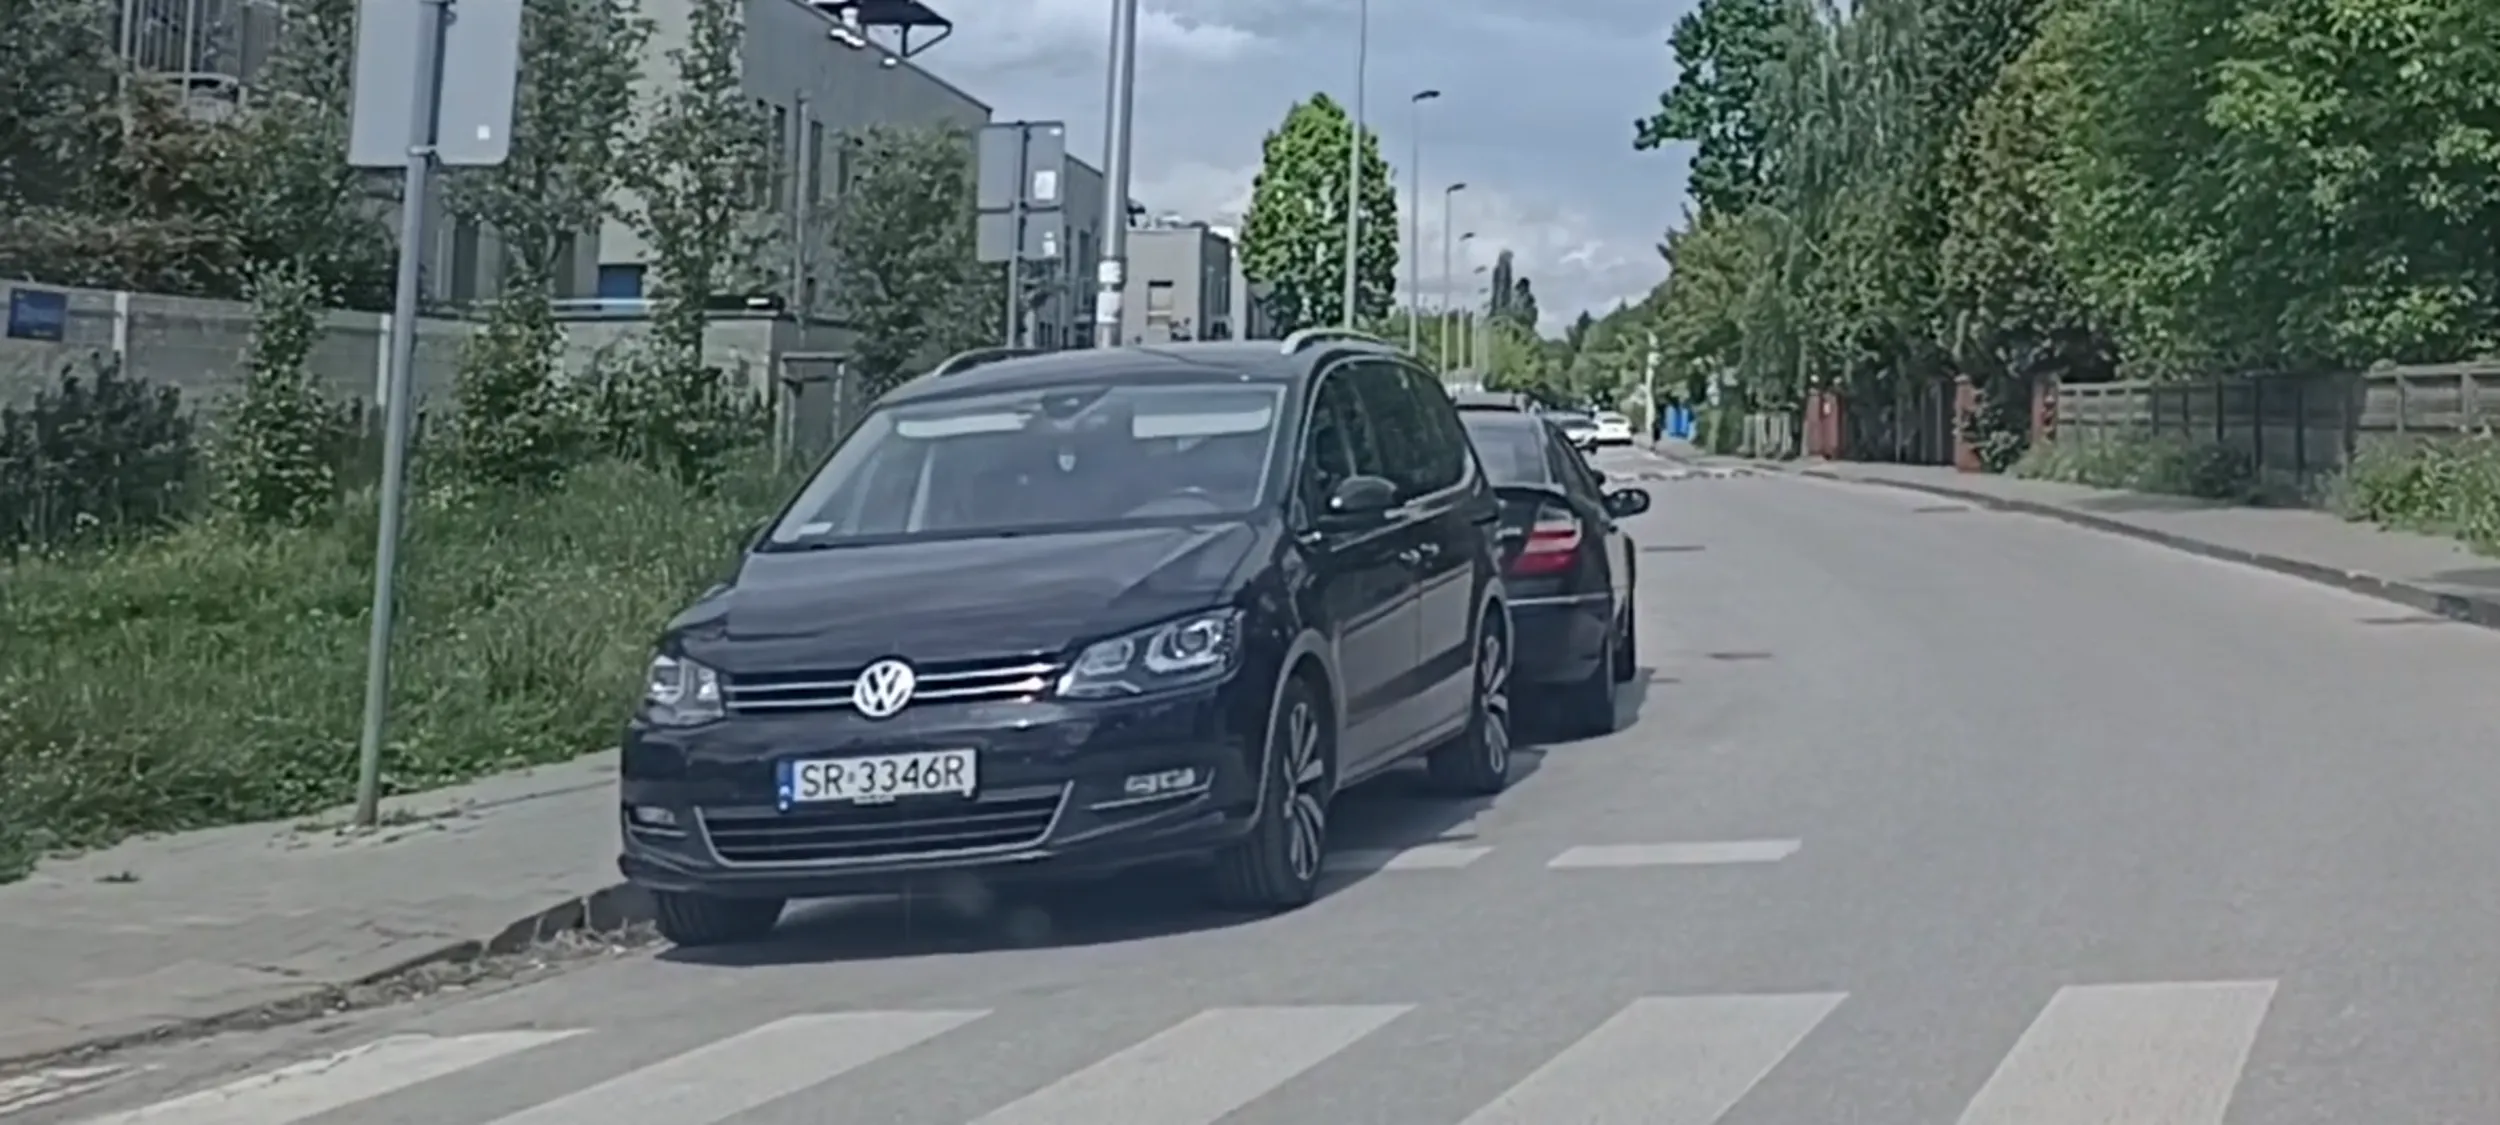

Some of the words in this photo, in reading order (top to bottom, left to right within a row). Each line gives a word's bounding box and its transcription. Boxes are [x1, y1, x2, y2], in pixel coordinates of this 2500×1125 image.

[854, 660, 915, 717] VW
[801, 763, 845, 797] SR
[859, 754, 965, 793] 3346R
